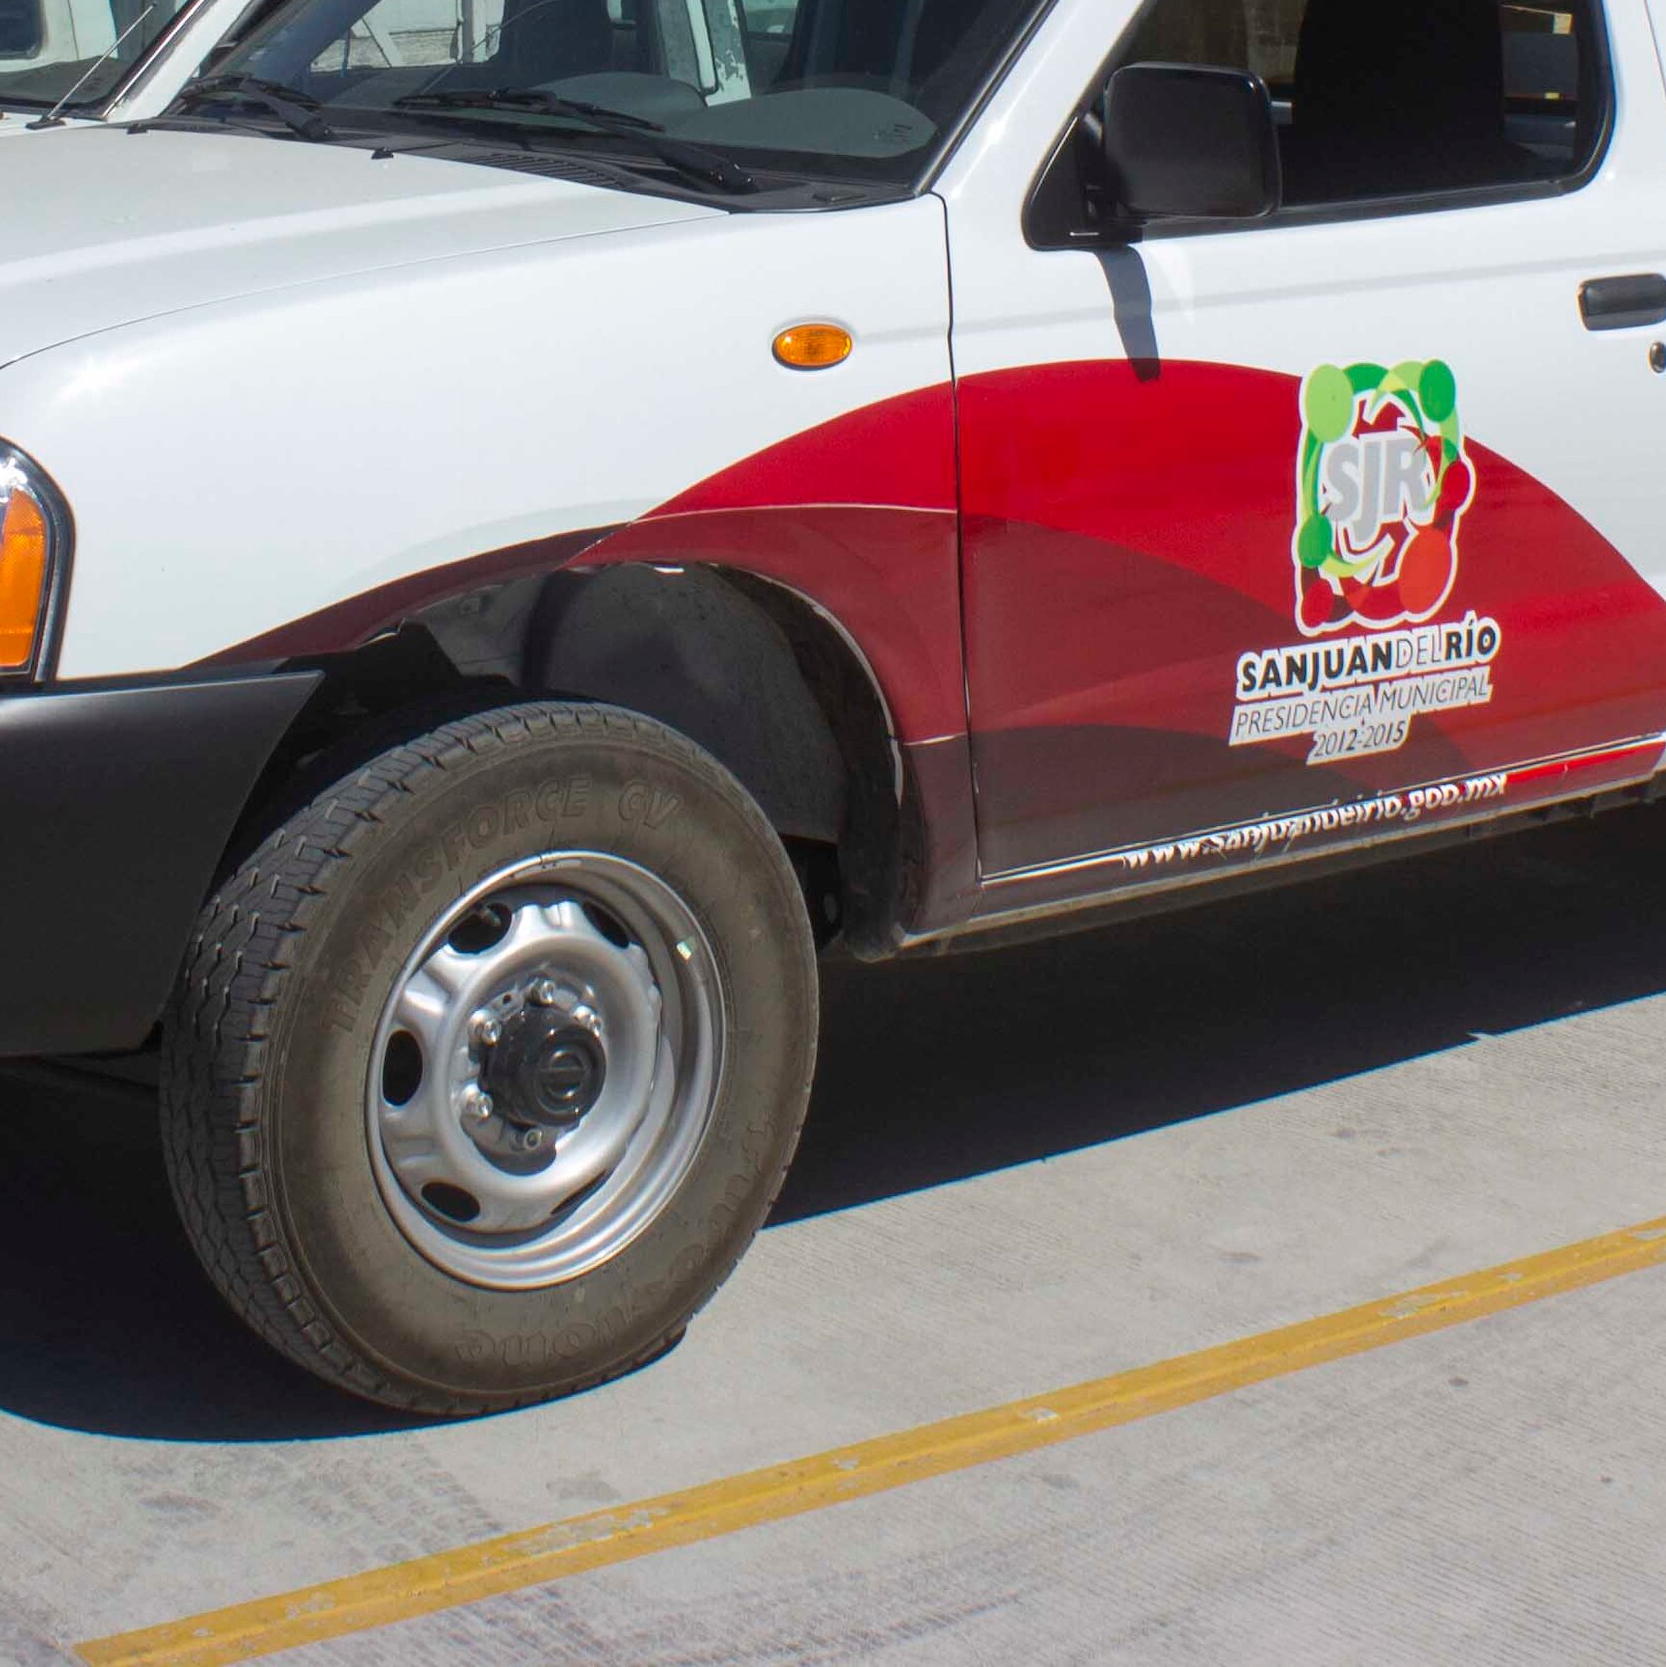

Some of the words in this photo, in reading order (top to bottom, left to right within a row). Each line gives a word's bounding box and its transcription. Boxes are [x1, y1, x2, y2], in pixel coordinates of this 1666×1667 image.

[1326, 436, 1427, 544] SJR
[1234, 694, 1372, 738] PRESIDENCIA
[1378, 674, 1488, 711] MUNICIPAL
[1313, 721, 1407, 757] 2012-2015
